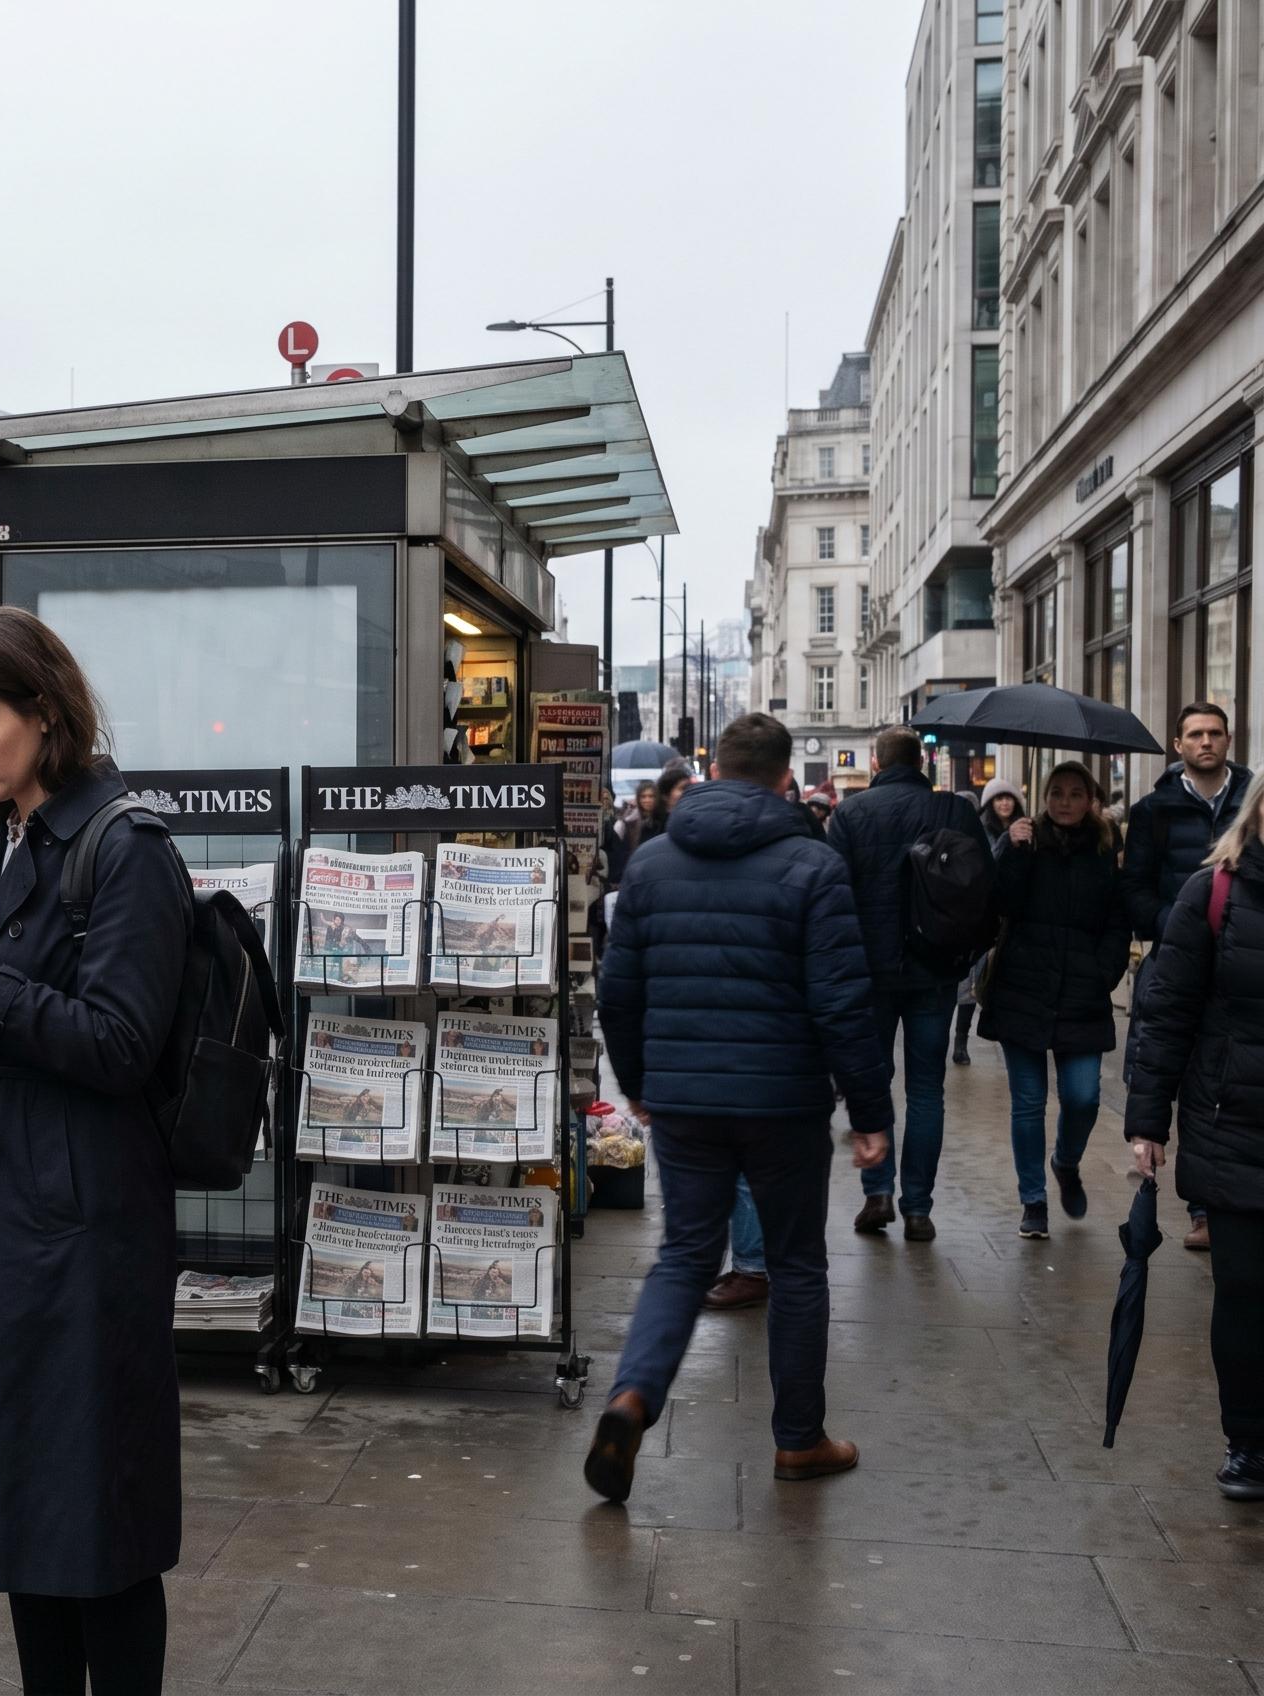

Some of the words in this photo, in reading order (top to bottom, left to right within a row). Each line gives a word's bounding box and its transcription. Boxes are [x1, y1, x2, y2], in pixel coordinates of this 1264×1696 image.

[287, 327, 309, 355] L
[179, 789, 273, 813] TIMES
[318, 786, 382, 810] THE
[449, 784, 546, 809] TIMES
[443, 850, 471, 864] THE
[501, 857, 545, 868] TIMES
[311, 1019, 340, 1033] THE
[371, 1027, 414, 1041] TIMES
[441, 1018, 471, 1031] THE
[502, 1024, 547, 1038] TIMES
[316, 1189, 344, 1205] THE
[373, 1199, 416, 1215] TIMES
[437, 1191, 468, 1205] THE
[497, 1195, 542, 1209] TIMES
